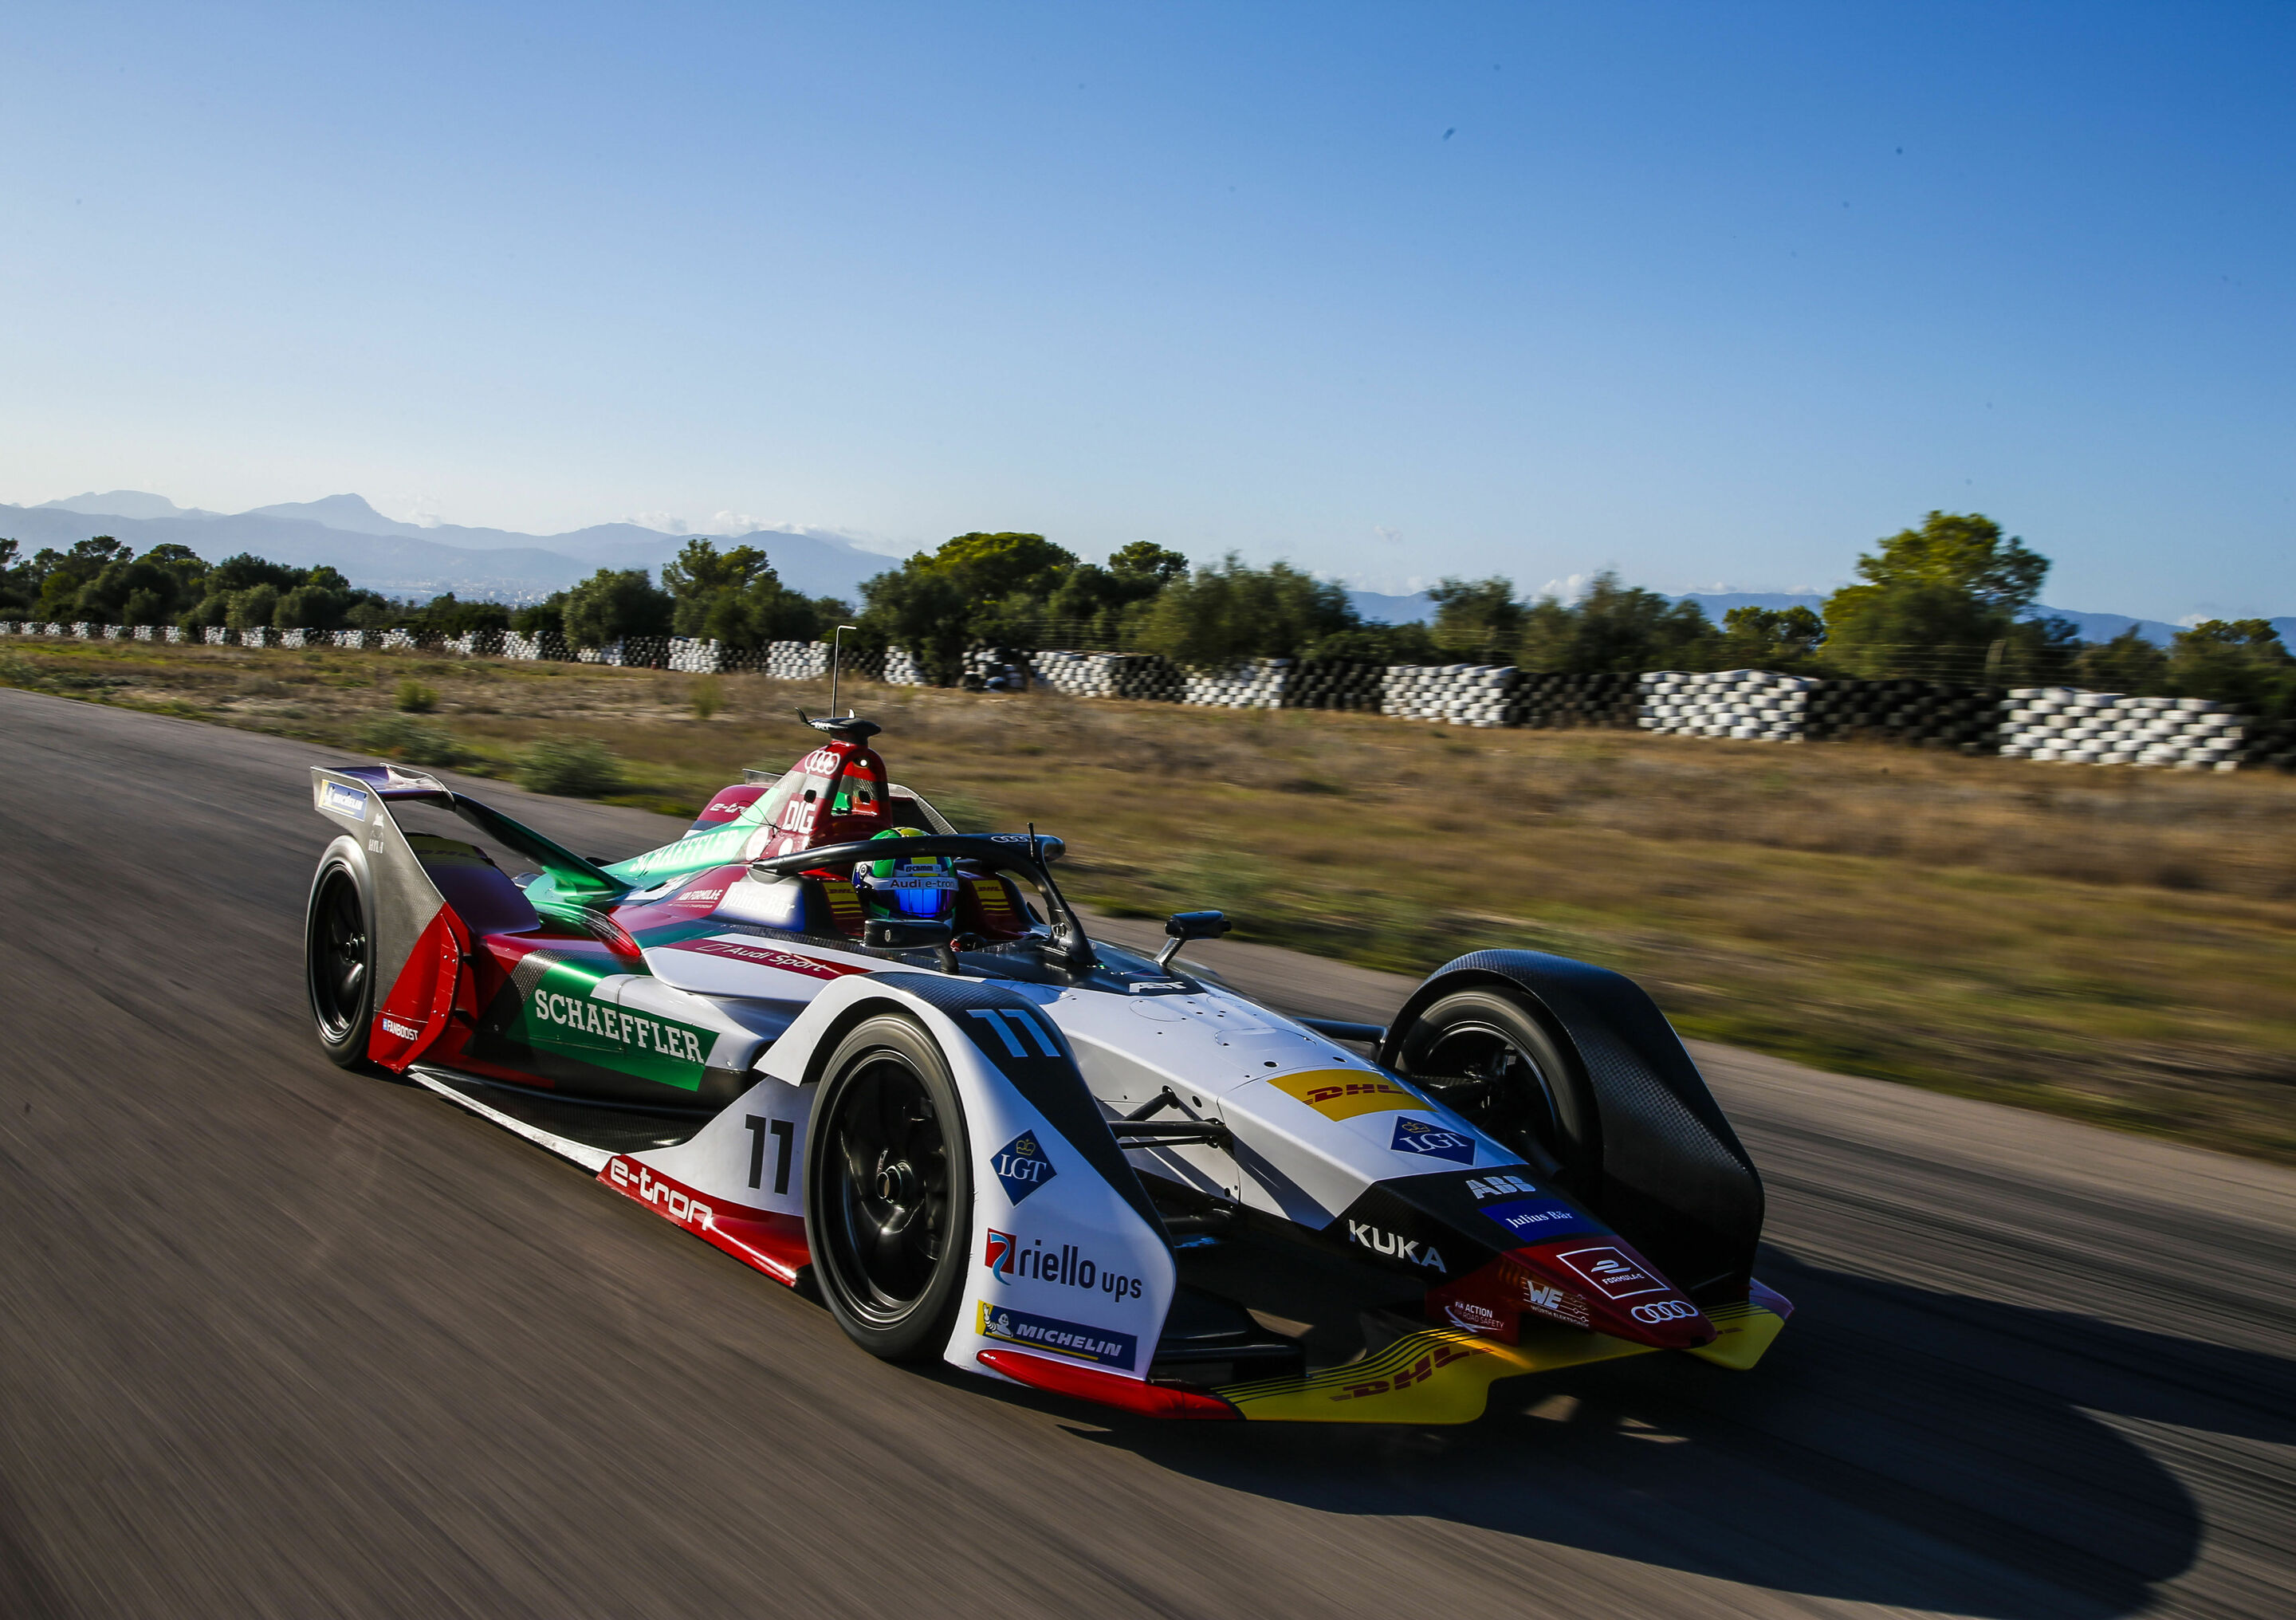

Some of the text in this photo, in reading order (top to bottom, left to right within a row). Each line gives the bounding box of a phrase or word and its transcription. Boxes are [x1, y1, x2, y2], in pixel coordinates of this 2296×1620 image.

[782, 800, 817, 834] DIG
[629, 830, 739, 872] SCHAEFFLER
[890, 879, 922, 888] Audi
[721, 887, 759, 911] Julius
[722, 947, 827, 972] Audi Sport
[534, 989, 705, 1064] SCHAEFFLER
[965, 1009, 1061, 1058] 11
[1305, 1083, 1406, 1103] DHL
[745, 1113, 795, 1196] 11
[1399, 1132, 1468, 1153] LGT
[998, 1154, 1047, 1182] LGT
[610, 1158, 714, 1231] e-tron
[1465, 1175, 1536, 1200] ABB
[1505, 1210, 1575, 1229] Julius Bär
[1348, 1219, 1447, 1274] KUKA
[1018, 1239, 1142, 1303] riello ups
[1527, 1280, 1563, 1309] WE
[1462, 1311, 1480, 1323] ROAD
[1480, 1316, 1504, 1329] SAFETY
[1464, 1303, 1493, 1319] ACTION
[1016, 1323, 1122, 1357] MICHELIN
[1342, 1347, 1470, 1398] DHL
